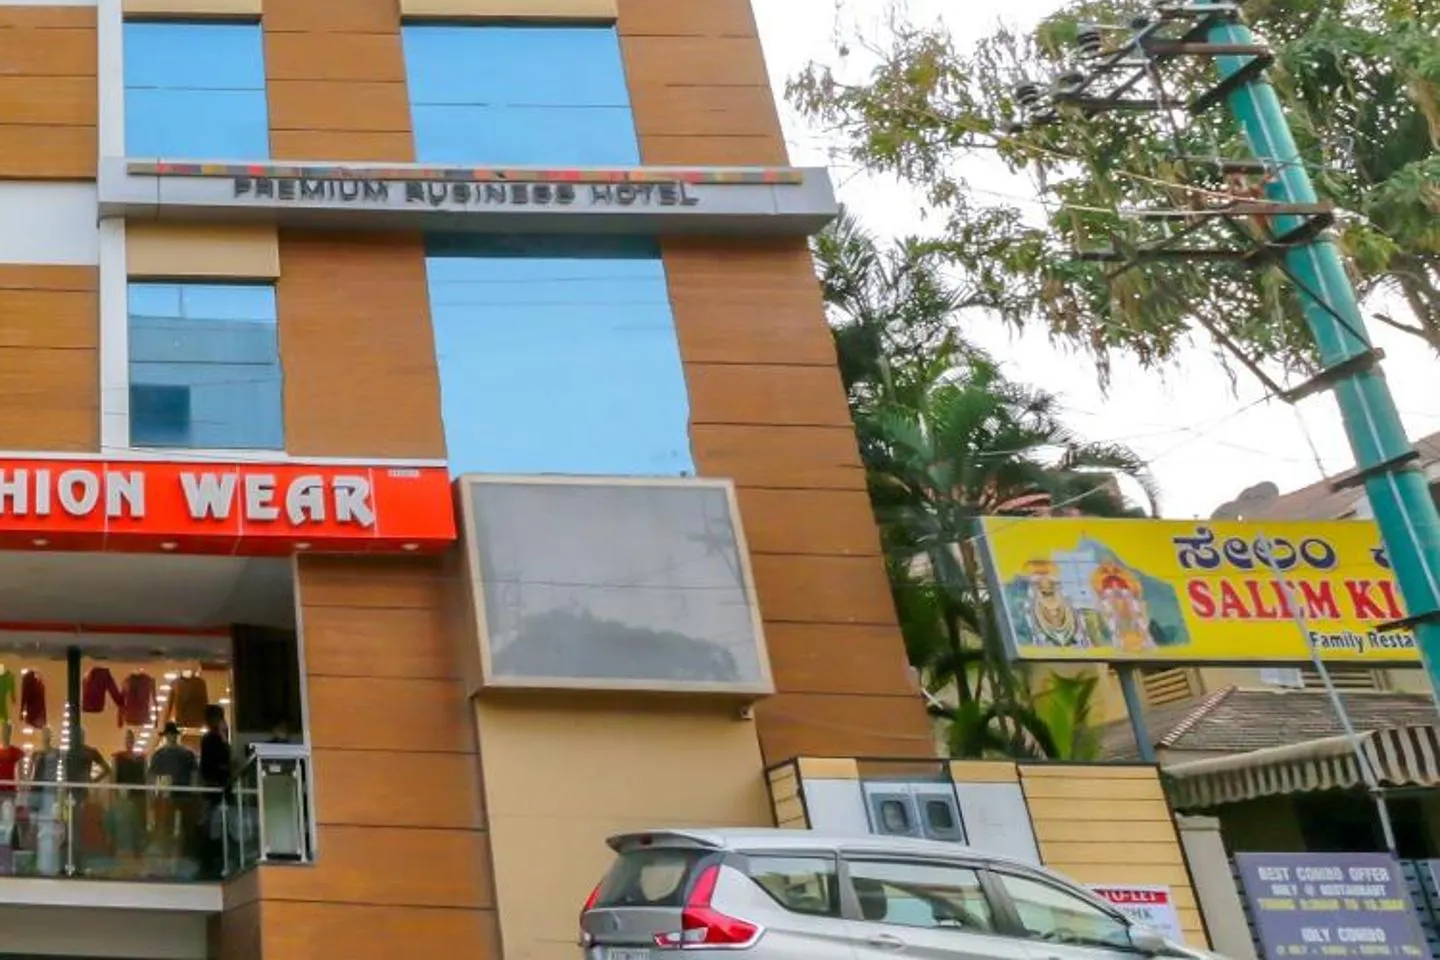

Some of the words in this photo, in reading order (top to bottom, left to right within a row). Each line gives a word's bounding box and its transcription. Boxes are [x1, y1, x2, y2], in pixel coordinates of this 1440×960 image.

[233, 178, 389, 202] PREMIUM
[405, 180, 575, 206] BUSINESS
[589, 181, 699, 207] HOTEL
[179, 471, 377, 528] WEAR
[1310, 630, 1364, 653] Family
